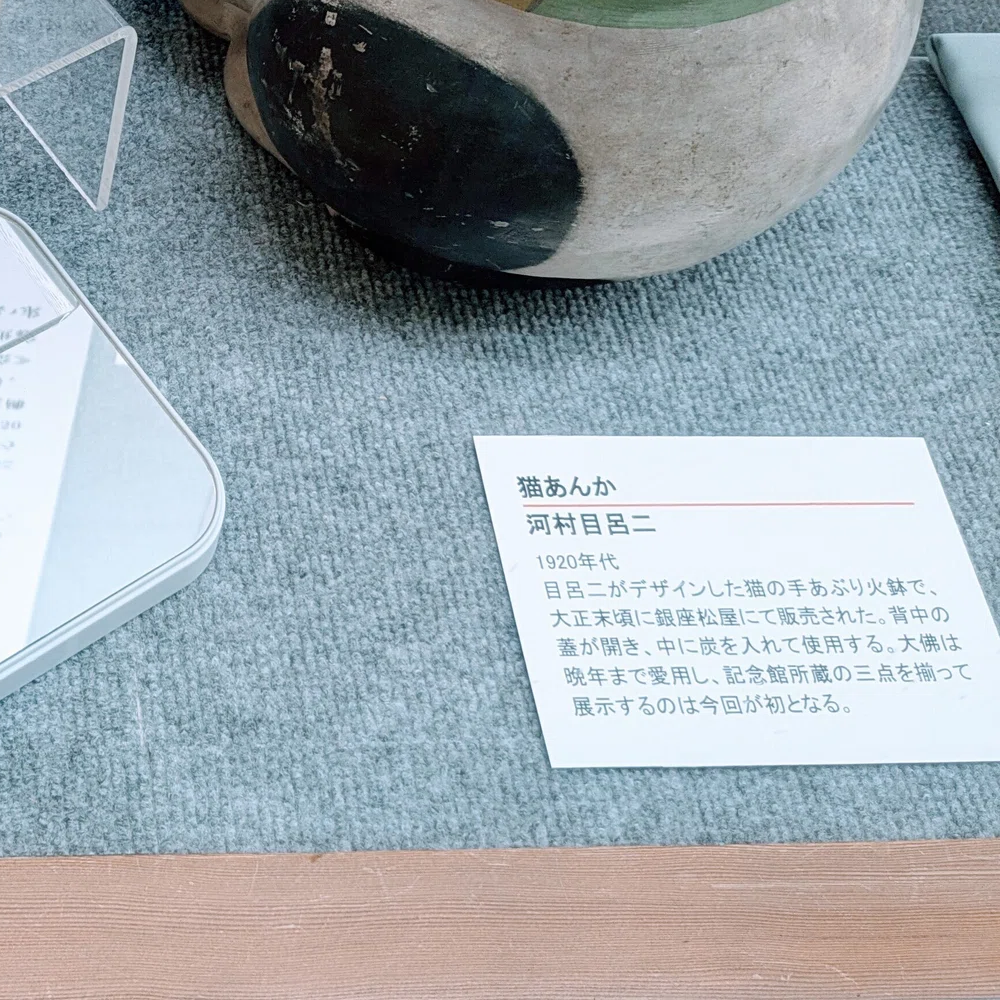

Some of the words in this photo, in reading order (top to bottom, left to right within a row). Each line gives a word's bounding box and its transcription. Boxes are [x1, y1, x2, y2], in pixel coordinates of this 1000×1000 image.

[516, 475, 617, 499] 猫あんか
[526, 512, 656, 536] 河村目呂二
[536, 552, 619, 571] 1920年代
[544, 578, 938, 600] 目呂二がデザインした猫の手あぶり火鉢で、
[550, 605, 950, 628] 大正末頃に銀座松屋にて販売された。背中の
[556, 633, 963, 657] 蓋が開き、中に炭を入れて使用する。大佛は
[563, 662, 972, 687] 晩年まで愛用し、記念館所蔵の三点を揃って
[572, 694, 852, 718] 展示するのは今回が初となる。
